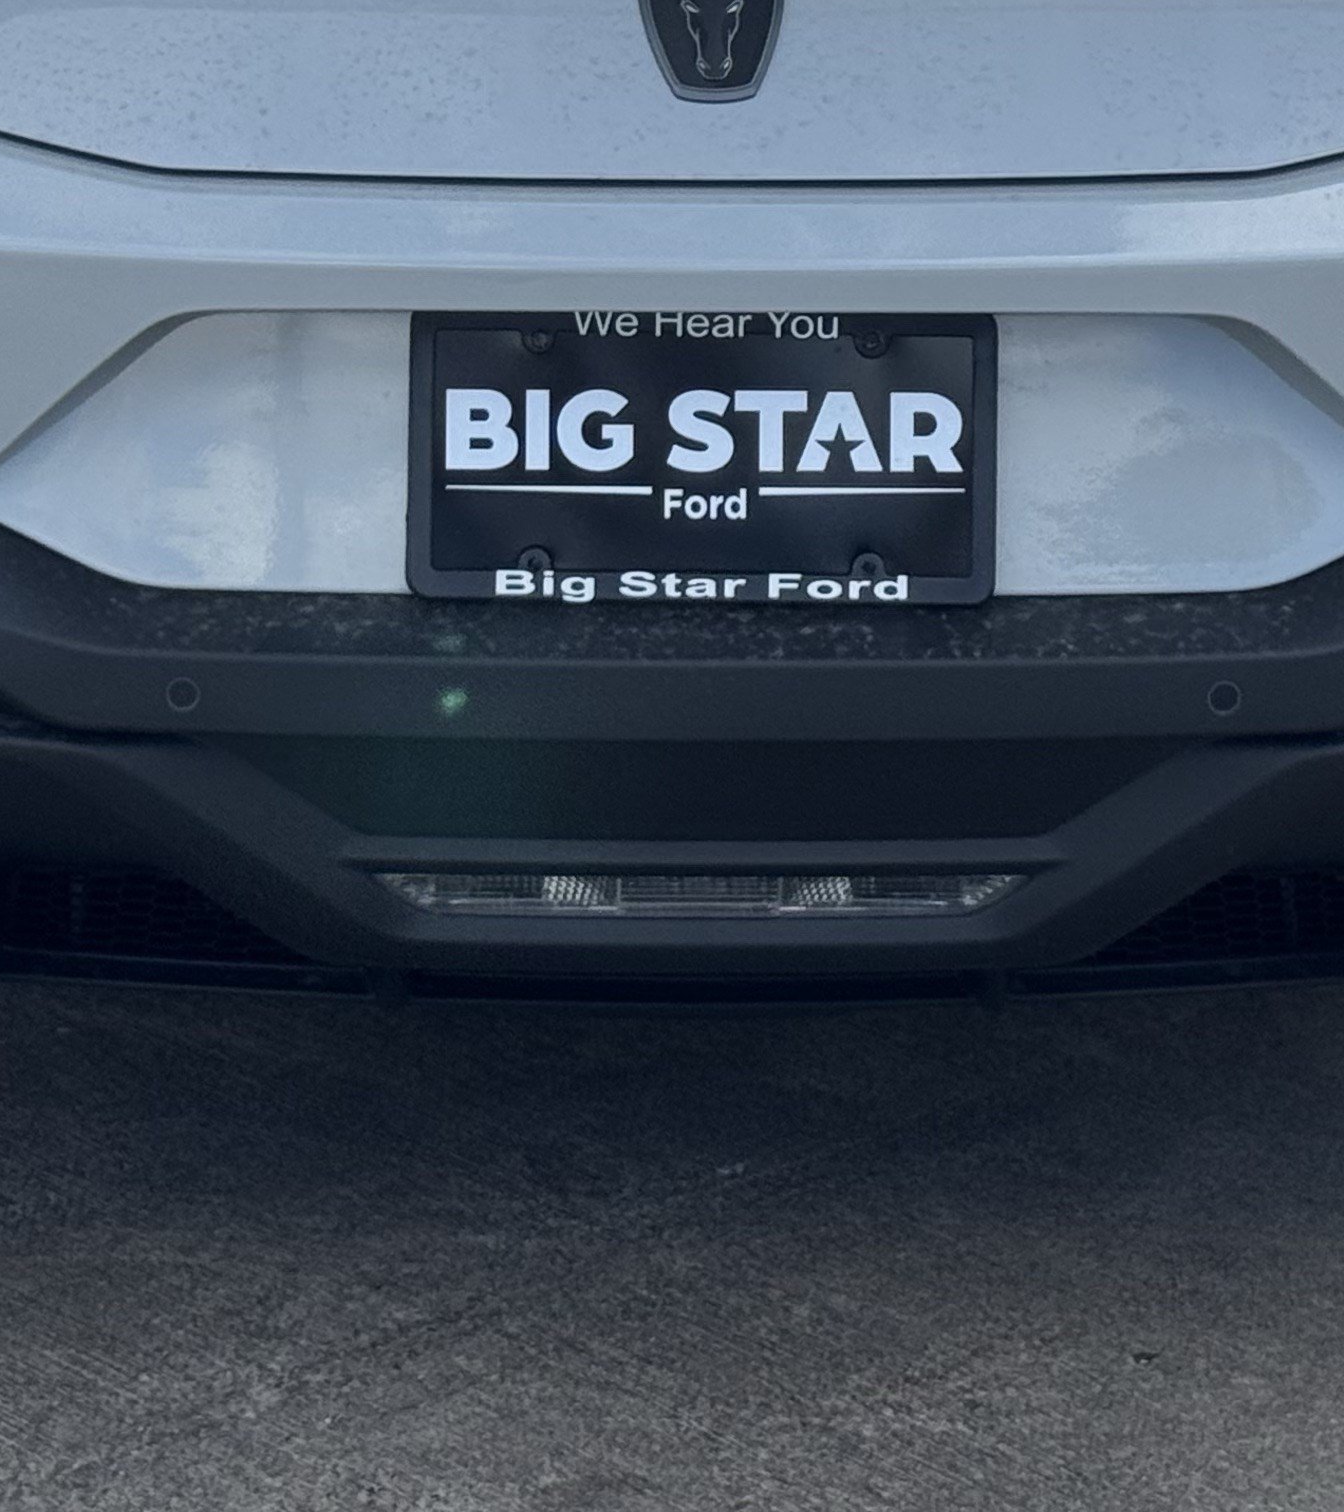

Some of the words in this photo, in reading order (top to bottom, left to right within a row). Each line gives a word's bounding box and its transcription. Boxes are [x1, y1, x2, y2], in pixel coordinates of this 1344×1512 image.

[574, 311, 640, 337] We
[654, 311, 753, 339] Hear
[767, 311, 839, 340] You
[444, 387, 635, 473] BIG
[665, 389, 964, 475] STAR
[662, 487, 748, 521] Ford
[493, 568, 597, 604] Big
[618, 569, 748, 600] Star
[766, 572, 910, 602] Ford
